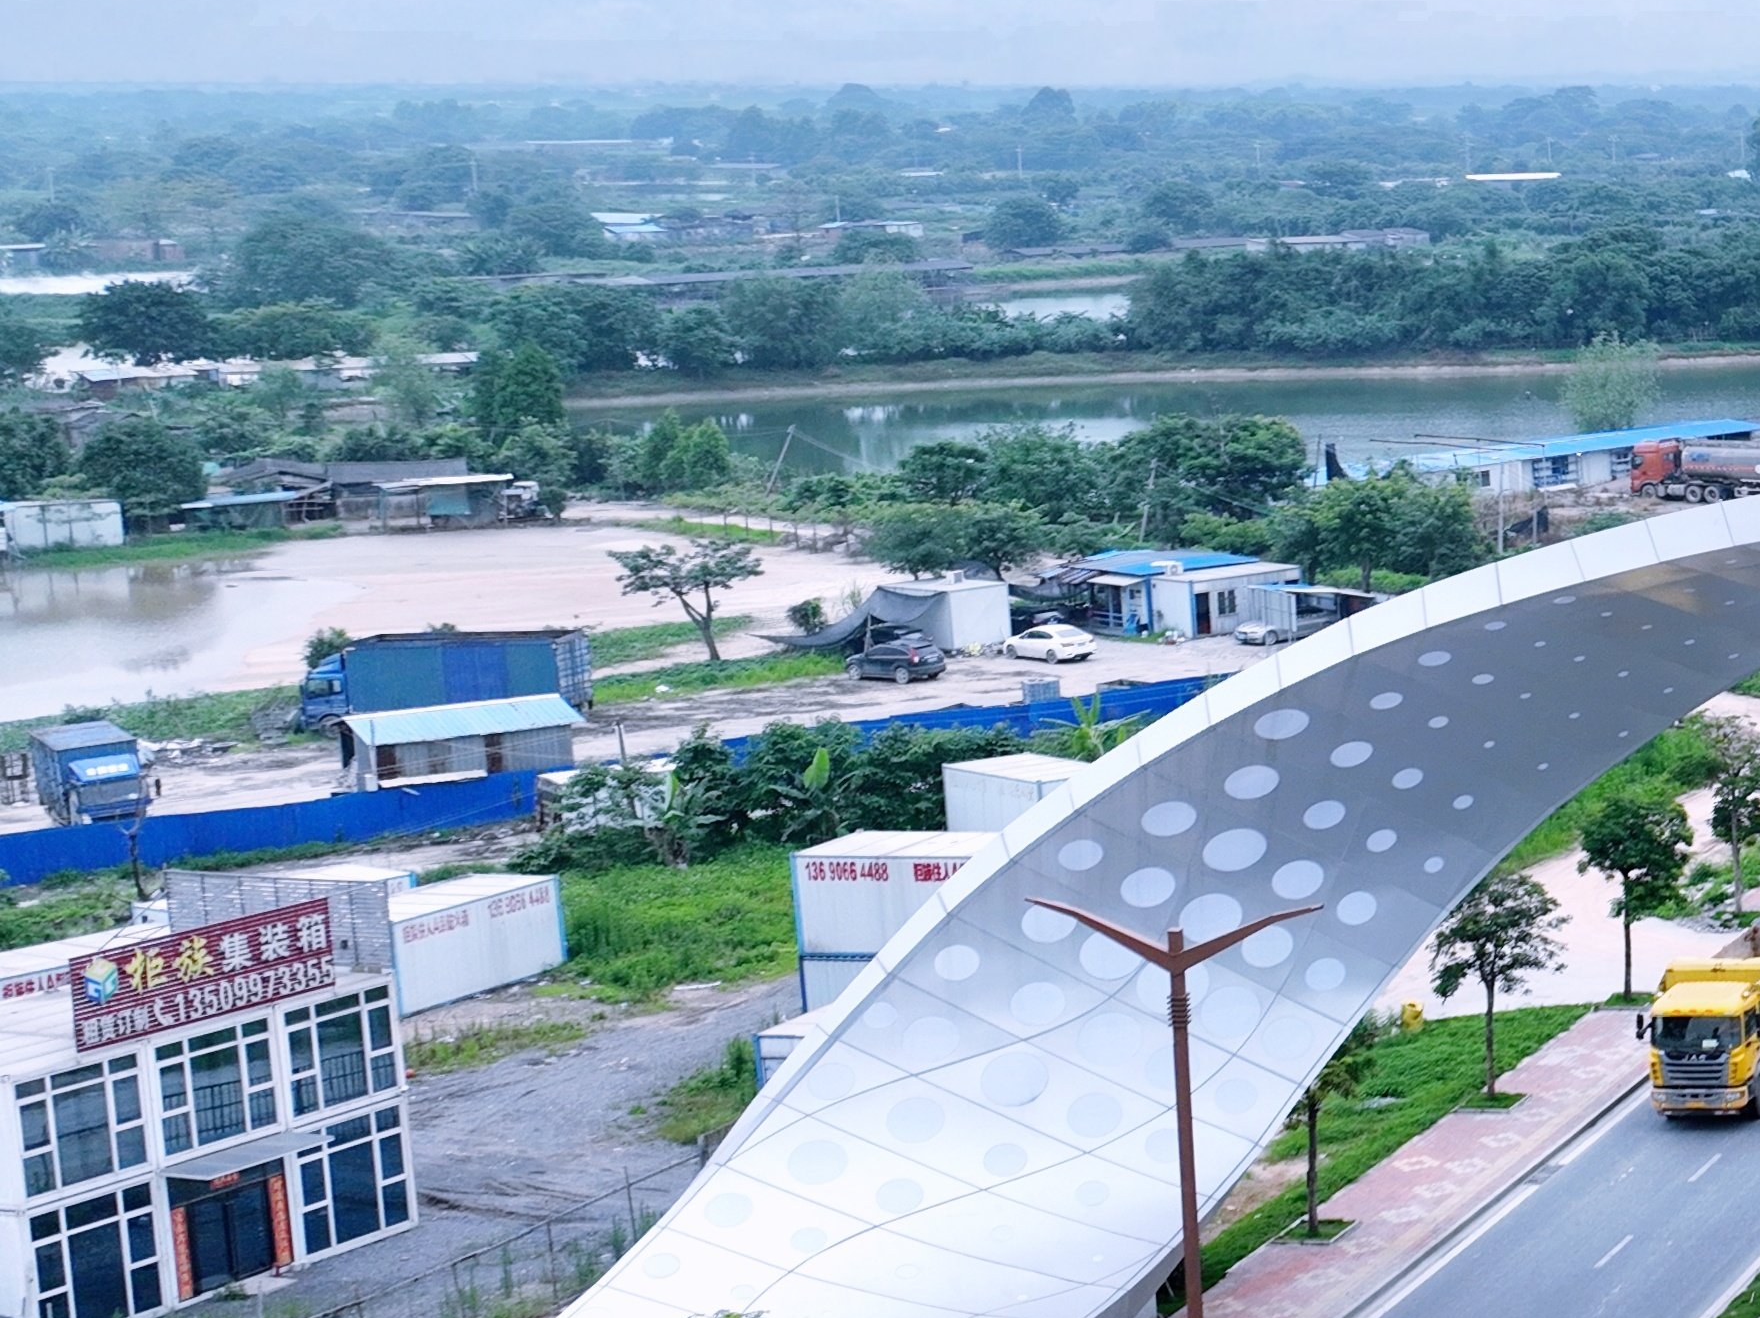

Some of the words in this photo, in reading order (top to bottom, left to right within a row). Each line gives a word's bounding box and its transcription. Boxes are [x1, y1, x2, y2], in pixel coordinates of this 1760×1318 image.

[805, 861, 826, 881] 136
[860, 862, 889, 881] 4488
[175, 954, 336, 1023] 13509973355
